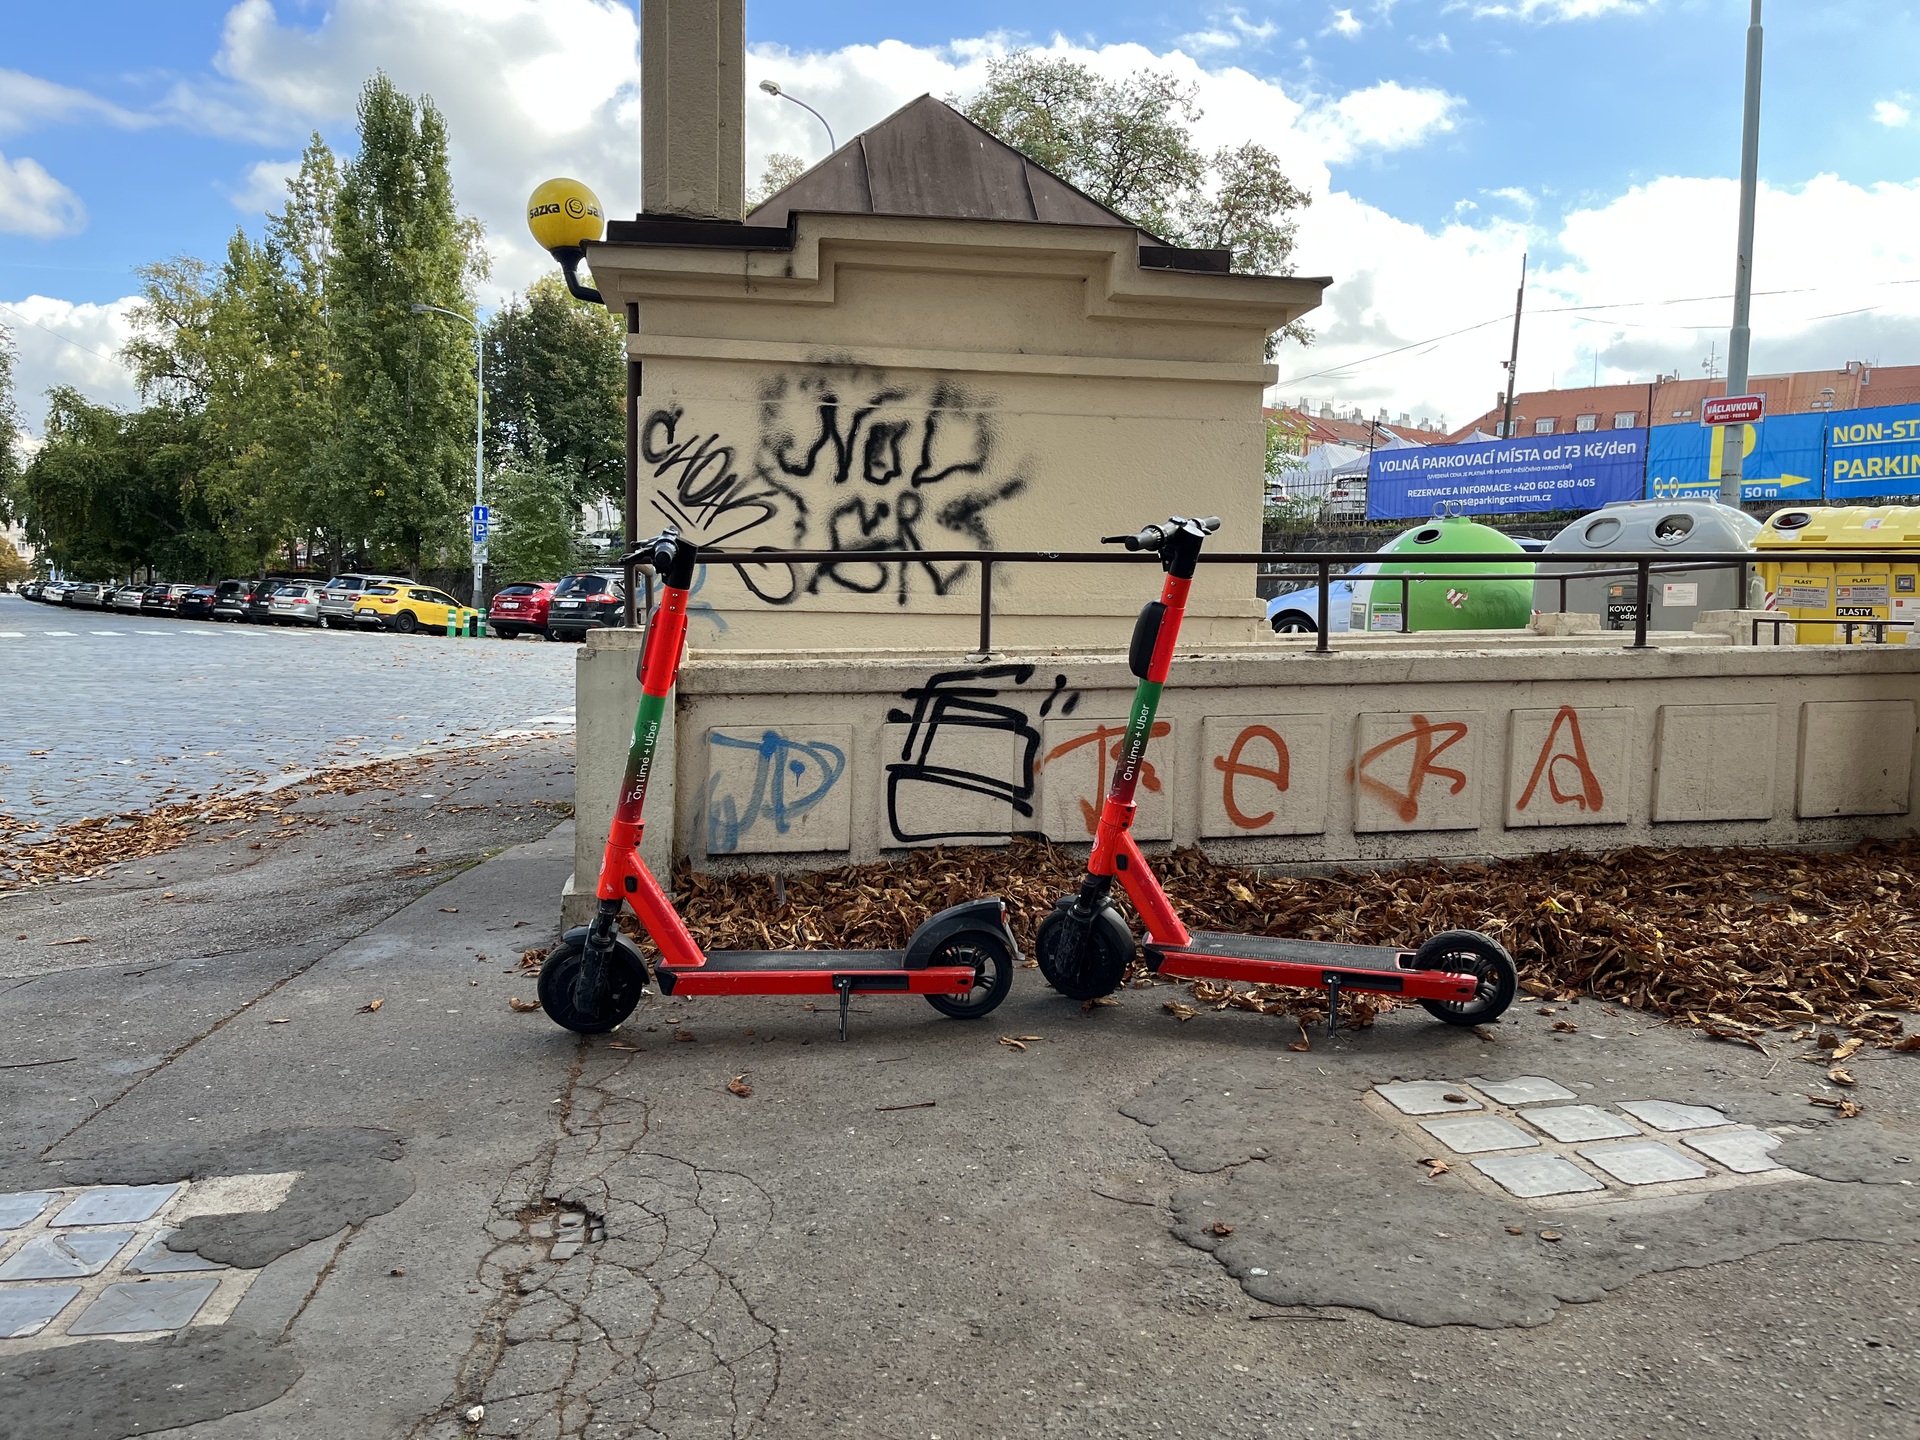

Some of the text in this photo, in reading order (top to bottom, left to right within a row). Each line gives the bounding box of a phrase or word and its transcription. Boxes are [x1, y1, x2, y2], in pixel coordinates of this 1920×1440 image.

[1706, 402, 1758, 414] VÁCLAVKOVA
[1833, 420, 1920, 444] NON-ST
[1379, 441, 1636, 472] VOLNÁ PARKOVACÍ MÍSTA od 73 Kč/den
[1408, 478, 1596, 498] REZERVACE A INFORMACE: +420 602 680 405
[1744, 487, 1762, 498] 50
[1765, 488, 1778, 498] m
[1837, 608, 1871, 616] PLASTY
[1136, 704, 1150, 730] Uber
[645, 720, 658, 746] Uber
[1126, 740, 1141, 764] Lime
[636, 757, 650, 782] Lime
[1123, 766, 1135, 781] On
[633, 784, 644, 800] On
